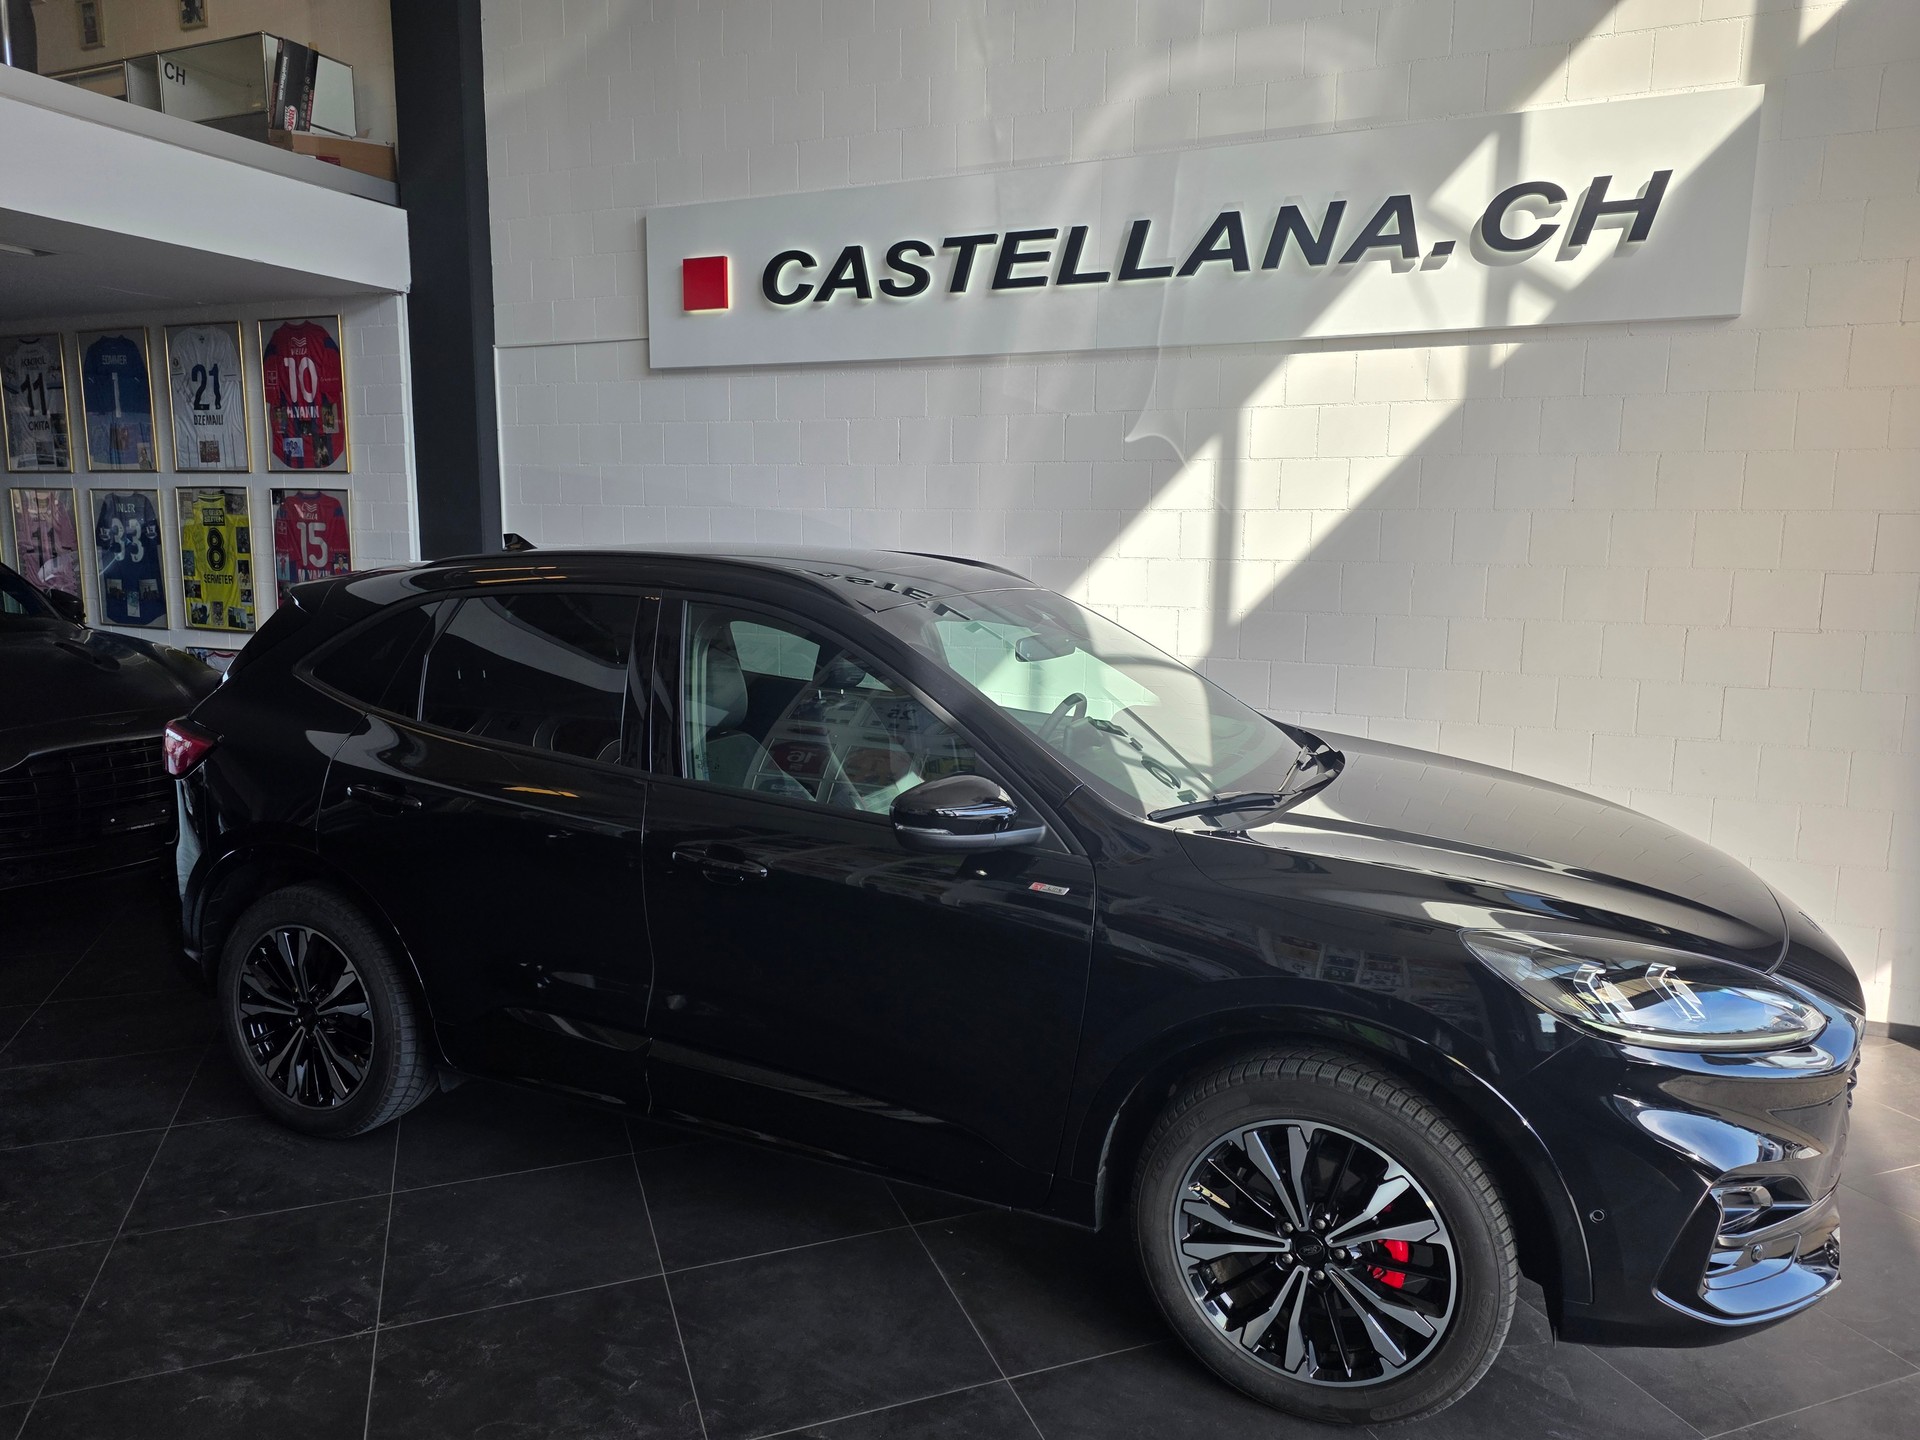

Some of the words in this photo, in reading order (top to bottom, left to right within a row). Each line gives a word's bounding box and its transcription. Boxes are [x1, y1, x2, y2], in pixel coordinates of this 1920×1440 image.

[164, 62, 185, 85] CH
[761, 169, 1674, 306] CASTELLANA.CH
[20, 372, 47, 417] 11
[112, 372, 122, 418] 1
[191, 363, 222, 411] 21
[283, 356, 318, 403] 10
[111, 518, 144, 563] 33
[207, 527, 226, 571] 8
[296, 522, 328, 568] 15
[203, 573, 234, 585] SERMETER
